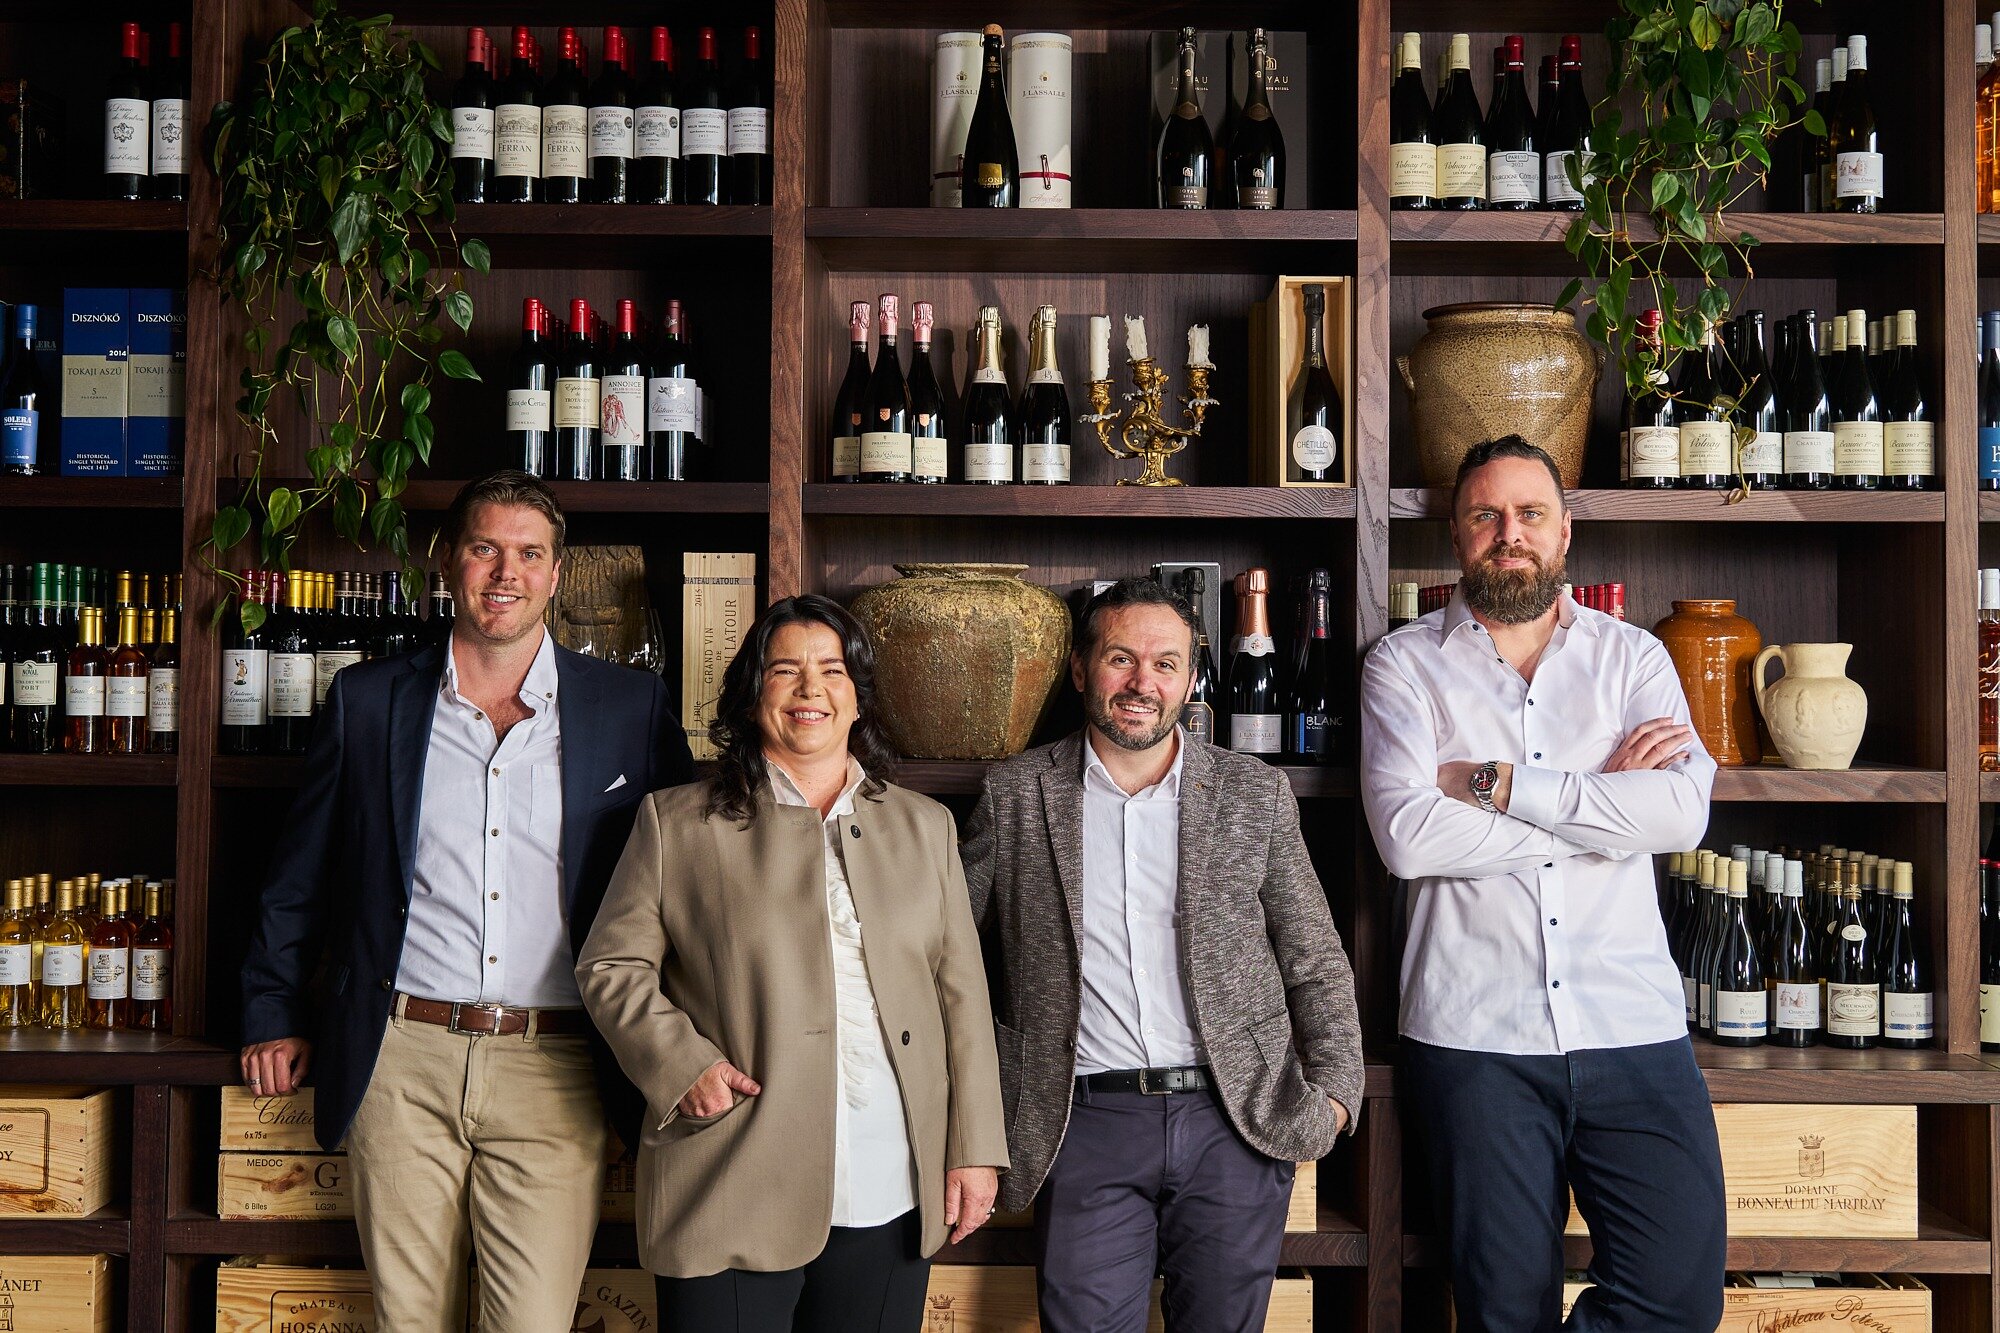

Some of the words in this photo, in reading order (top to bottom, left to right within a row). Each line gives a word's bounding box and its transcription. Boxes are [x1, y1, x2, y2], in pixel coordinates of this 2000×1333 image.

[498, 143, 532, 153] FERRAN
[547, 143, 582, 154] FERRAN
[68, 368, 97, 376] TOKAJI
[134, 367, 164, 375] TOKAJI
[167, 367, 185, 375] ASZ
[608, 381, 642, 389] ANNONCE
[1689, 437, 1721, 450] Volnay
[712, 577, 740, 585] LATOUR
[725, 599, 737, 651] LATOUR
[705, 626, 713, 646] VIN
[716, 650, 722, 660] DE
[705, 648, 713, 684] GRAND
[1306, 716, 1343, 726] BLANC
[246, 1159, 283, 1167] MEDOC
[314, 1162, 341, 1189] G
[1785, 1185, 1839, 1195] DOMAINE
[315, 1202, 337, 1211] LG20
[1737, 1197, 1798, 1209] BONNEAU
[1801, 1198, 1818, 1210] DU
[1824, 1198, 1886, 1210] MARTRAY
[1, 1279, 42, 1292] ANET
[290, 1299, 357, 1314] CHATEAU
[596, 1285, 652, 1331] GAZIN
[280, 1322, 365, 1333] HOSANNA
